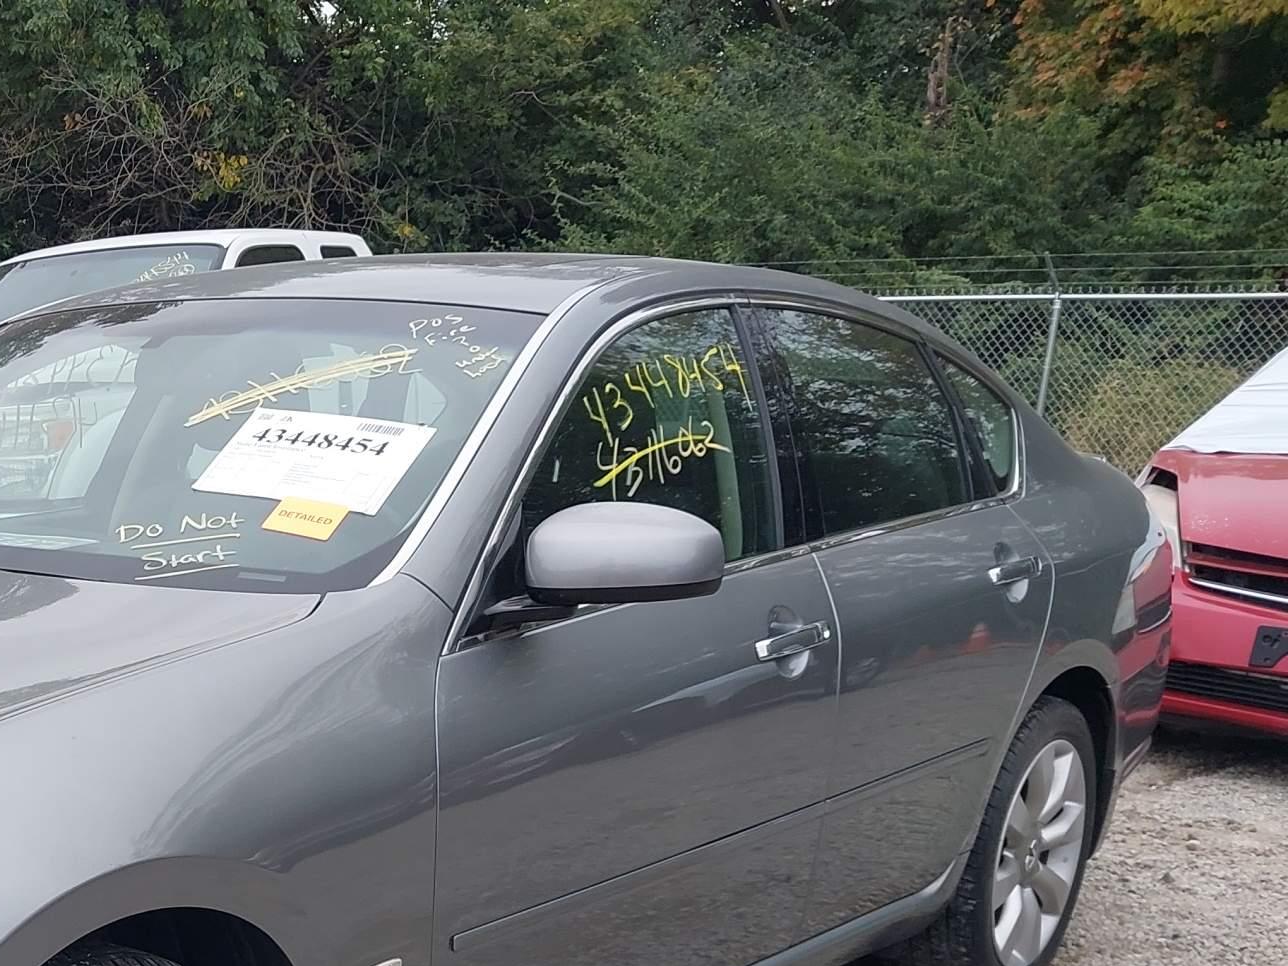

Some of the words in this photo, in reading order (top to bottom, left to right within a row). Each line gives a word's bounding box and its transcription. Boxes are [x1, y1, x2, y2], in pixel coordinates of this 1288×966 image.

[252, 427, 390, 456] 43448454
[180, 511, 246, 533] Not
[277, 508, 333, 526] DETAILED
[140, 544, 238, 571] Start
